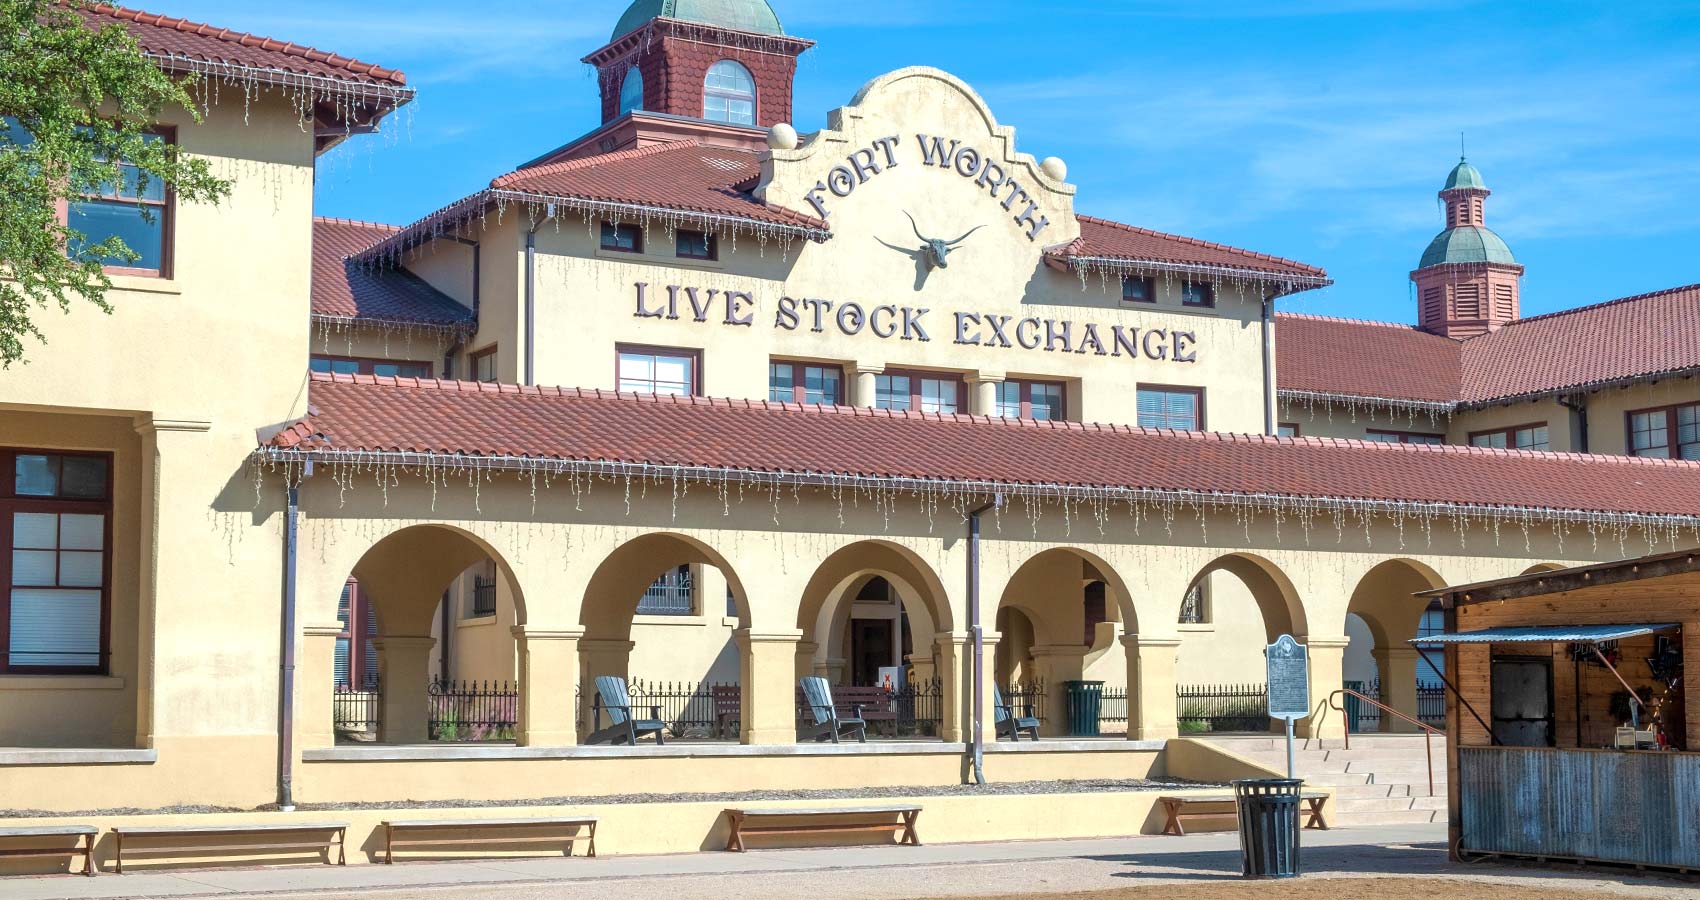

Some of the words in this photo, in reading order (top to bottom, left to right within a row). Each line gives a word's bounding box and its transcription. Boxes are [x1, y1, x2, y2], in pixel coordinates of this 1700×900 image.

[803, 134, 900, 220] FORT
[915, 133, 1050, 242] WORTH
[633, 281, 754, 327] LIVE
[774, 296, 931, 342] STOCK
[953, 311, 1197, 364] EXCHANGE
